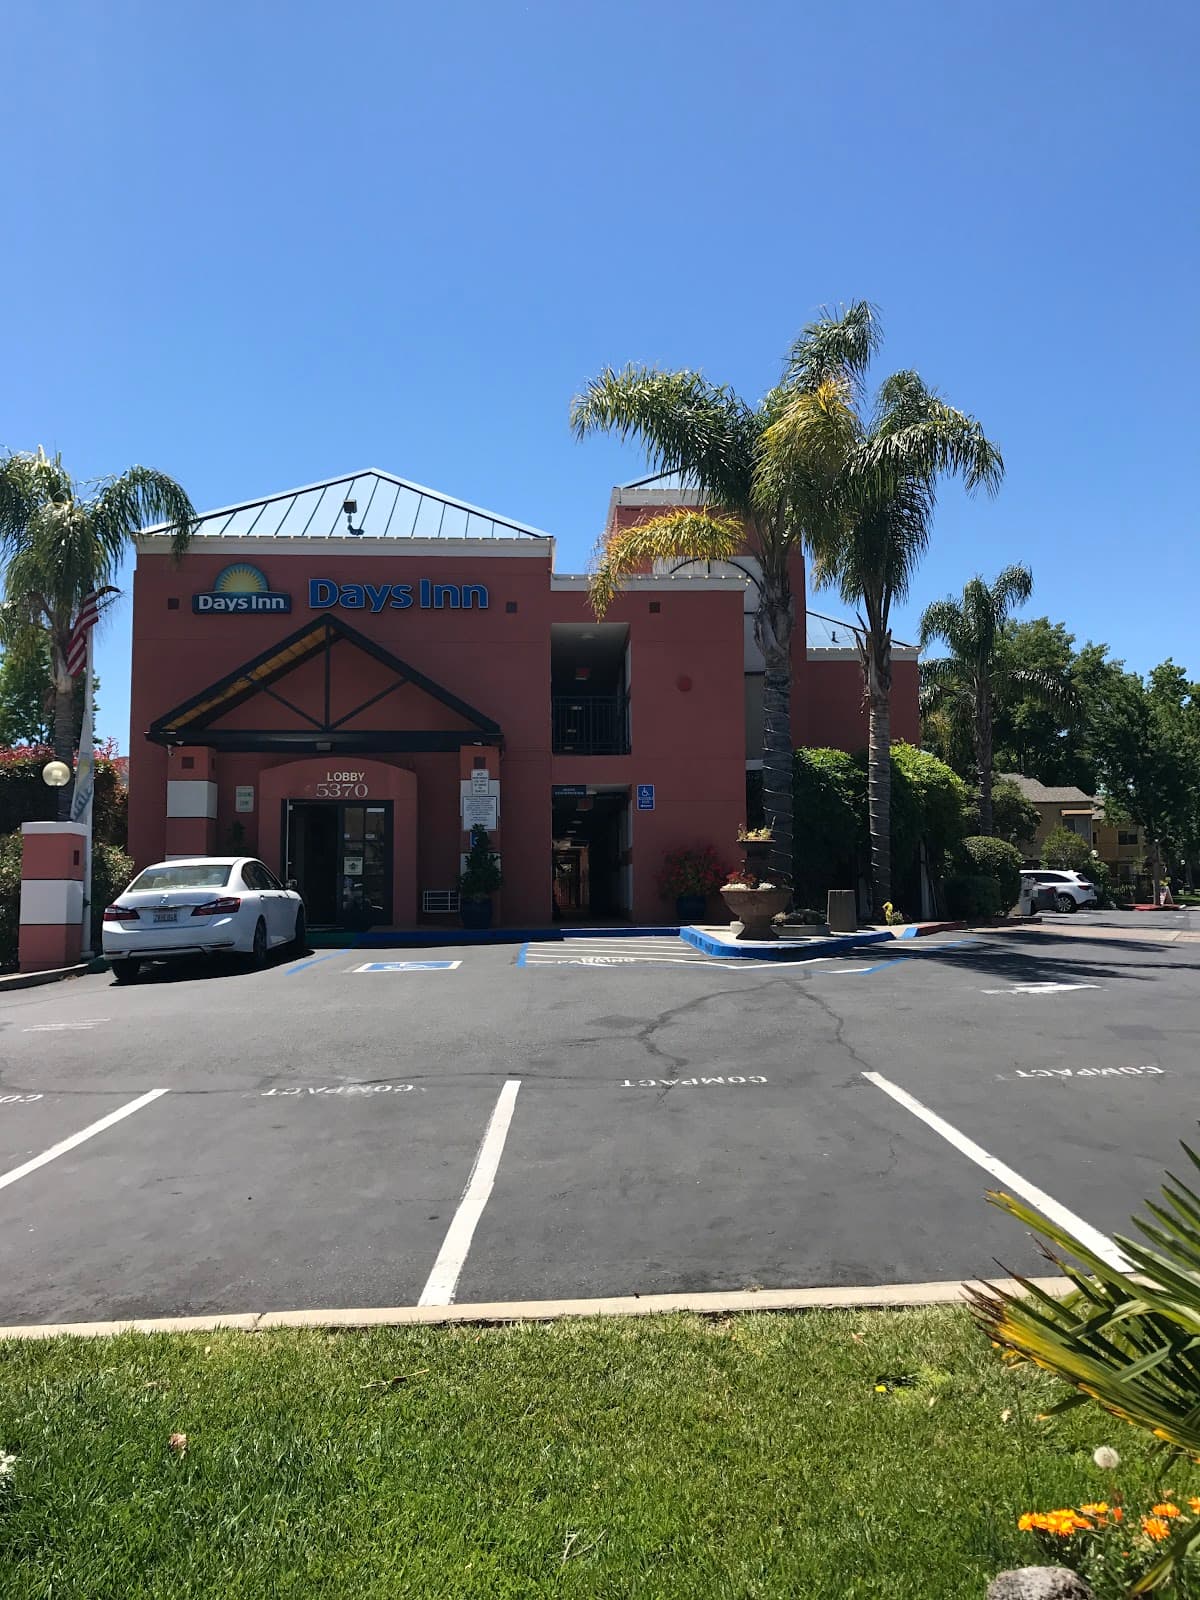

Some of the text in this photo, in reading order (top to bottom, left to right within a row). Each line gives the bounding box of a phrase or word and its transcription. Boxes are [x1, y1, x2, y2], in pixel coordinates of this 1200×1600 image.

[308, 578, 489, 613] Days Inn
[198, 595, 285, 612] Days Inn
[327, 772, 365, 782] LOBBY
[316, 783, 369, 798] 5370
[1015, 1066, 1165, 1078] COMPACT
[620, 1075, 768, 1087] COMPACT
[260, 1084, 414, 1096] COMPACT
[0, 1094, 43, 1103] CO
